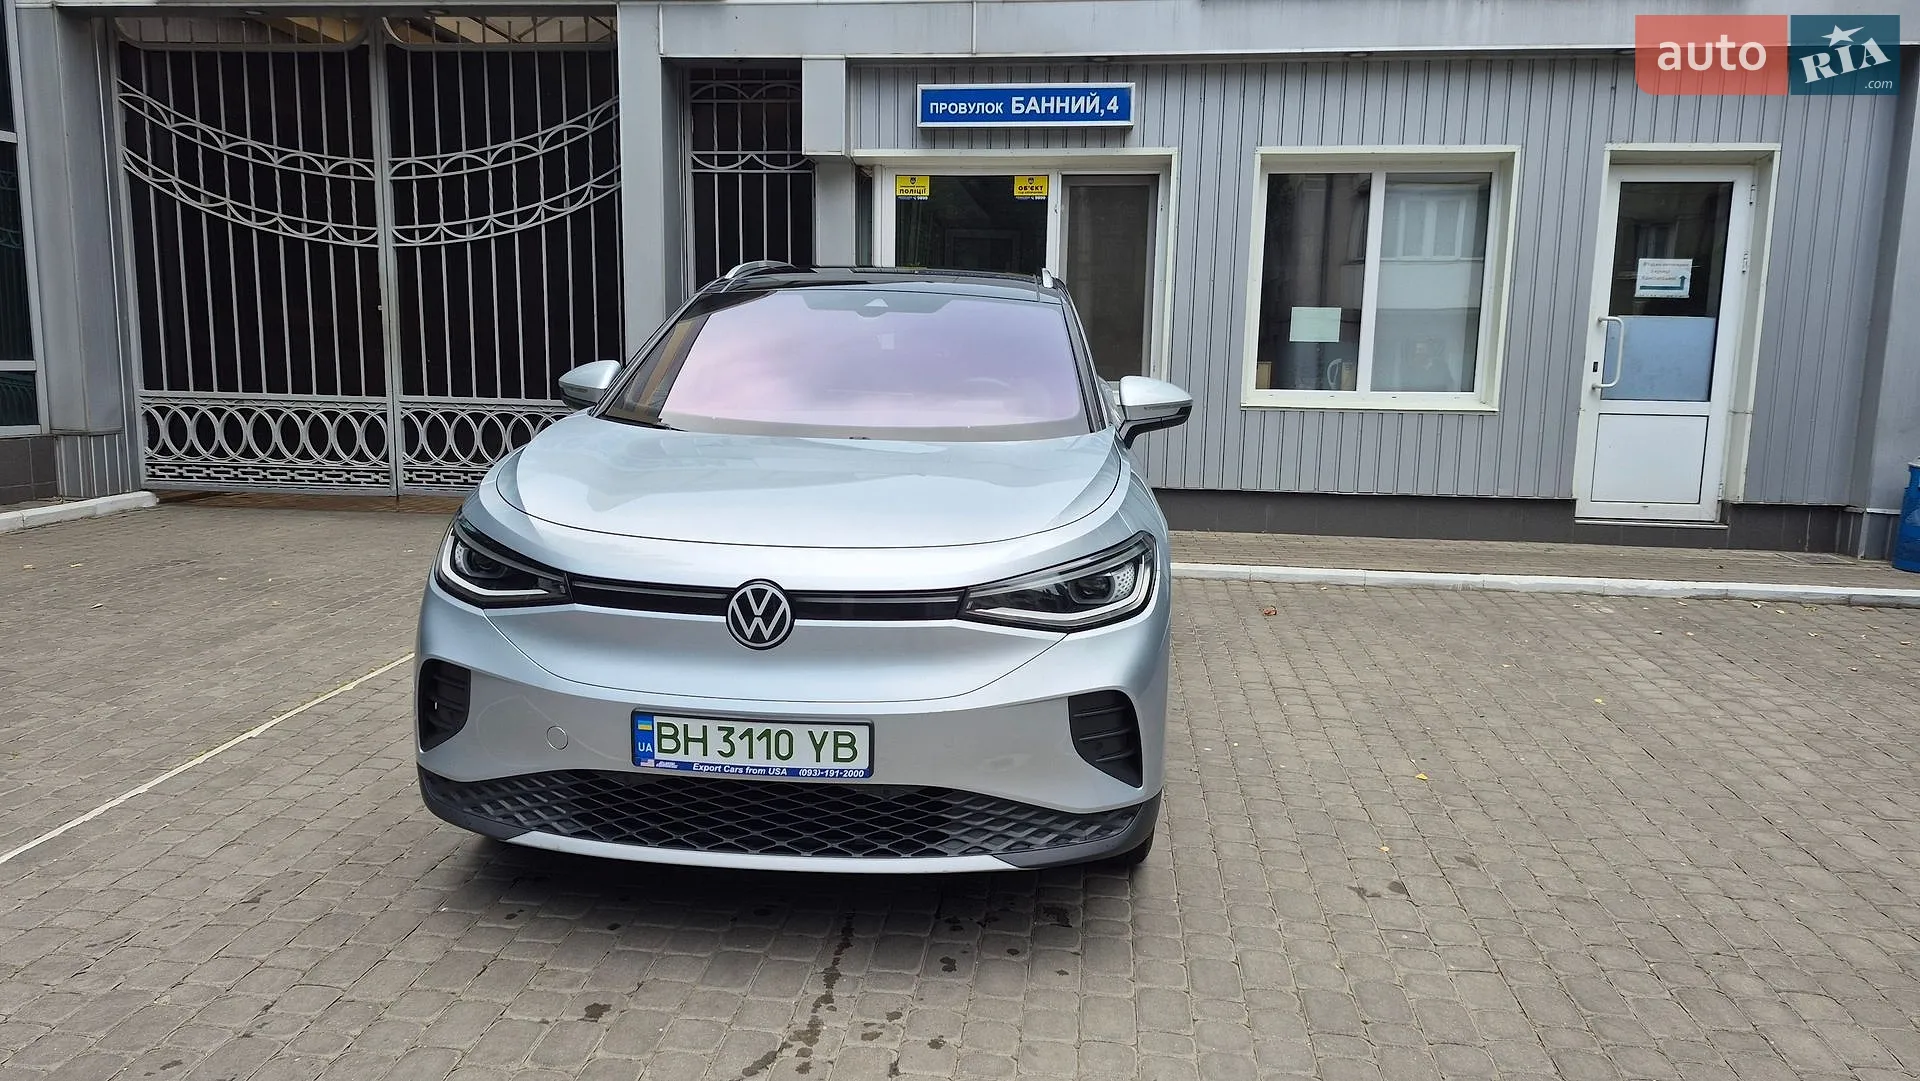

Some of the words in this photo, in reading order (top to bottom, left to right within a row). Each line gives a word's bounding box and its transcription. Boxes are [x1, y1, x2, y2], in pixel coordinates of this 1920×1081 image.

[929, 102, 1003, 114] ПРОВУЛОК
[638, 742, 653, 752] UA
[657, 722, 708, 757] BH
[717, 726, 794, 761] 3110
[807, 730, 858, 763] YB
[692, 762, 721, 773] Export
[723, 764, 744, 774] Cars
[745, 766, 766, 775] from
[768, 767, 787, 776] USA
[798, 768, 865, 778] (093)-191-2000
